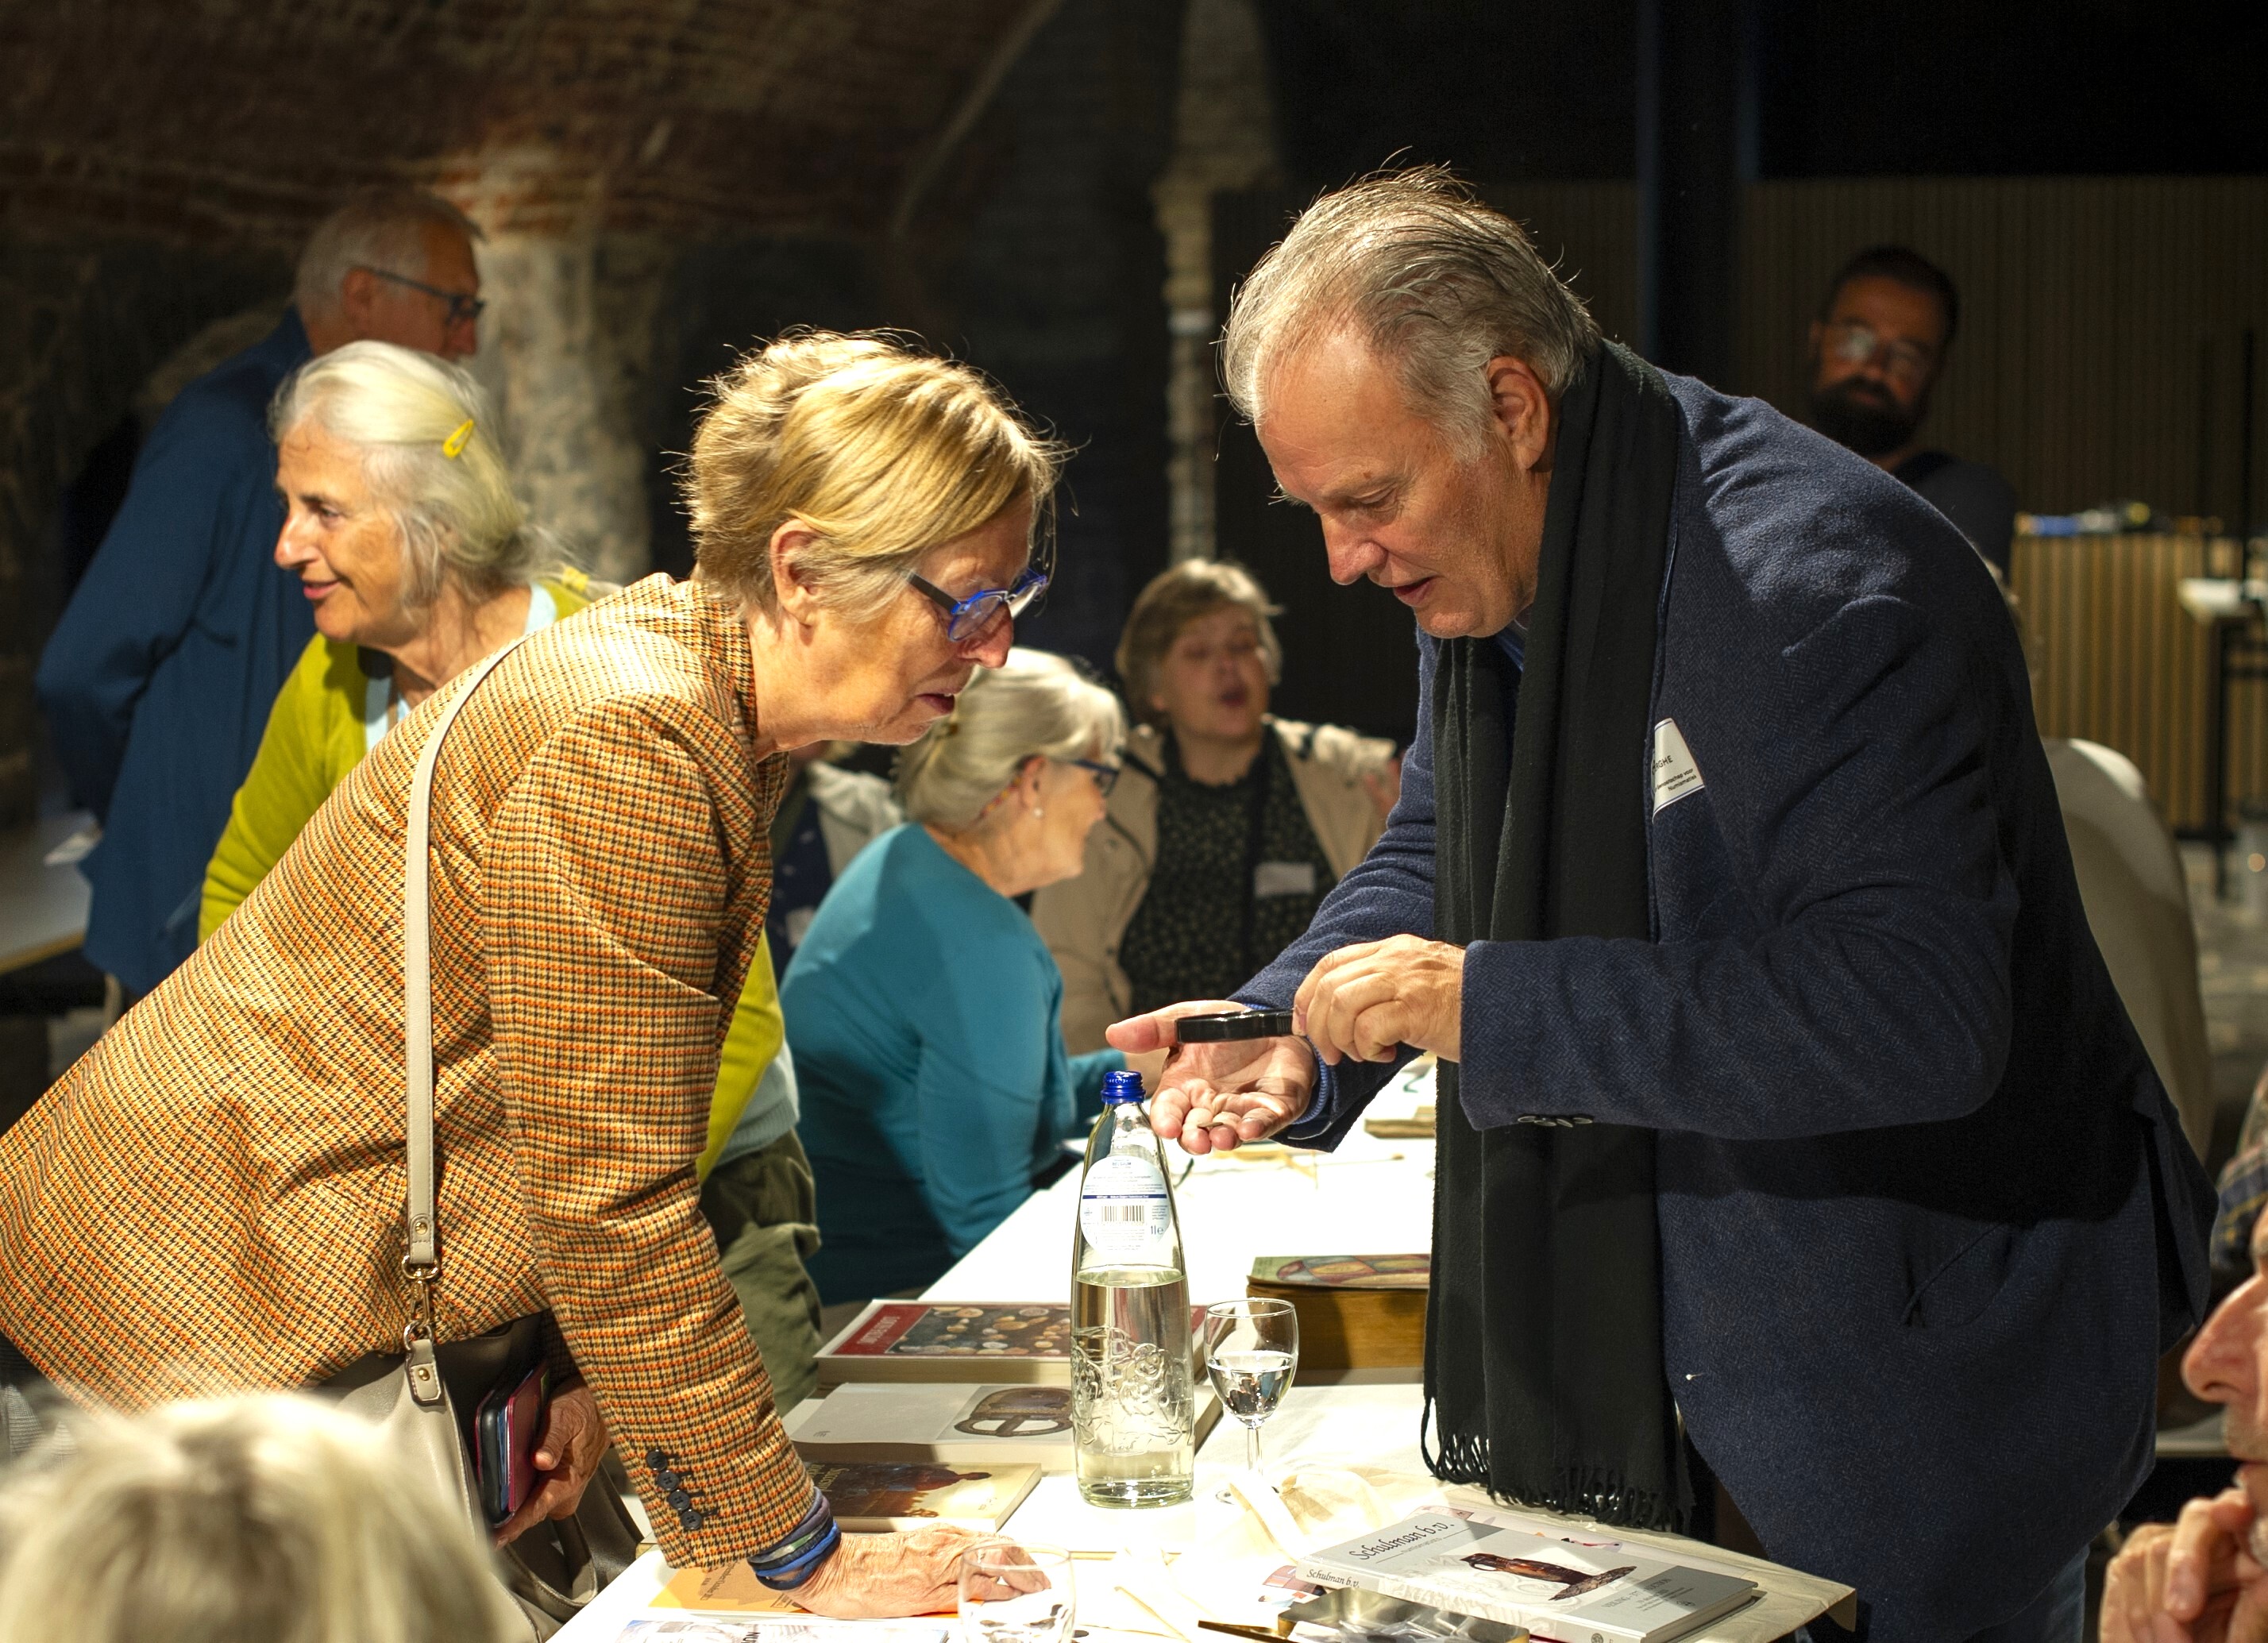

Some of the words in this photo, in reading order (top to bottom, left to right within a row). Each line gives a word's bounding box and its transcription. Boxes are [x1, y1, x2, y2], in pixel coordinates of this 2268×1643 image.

[1348, 1531, 1427, 1560] Schulman
[1414, 1522, 1455, 1535] b.v.
[1306, 1569, 1345, 1585] Schulman
[1345, 1576, 1360, 1588] b.v.
